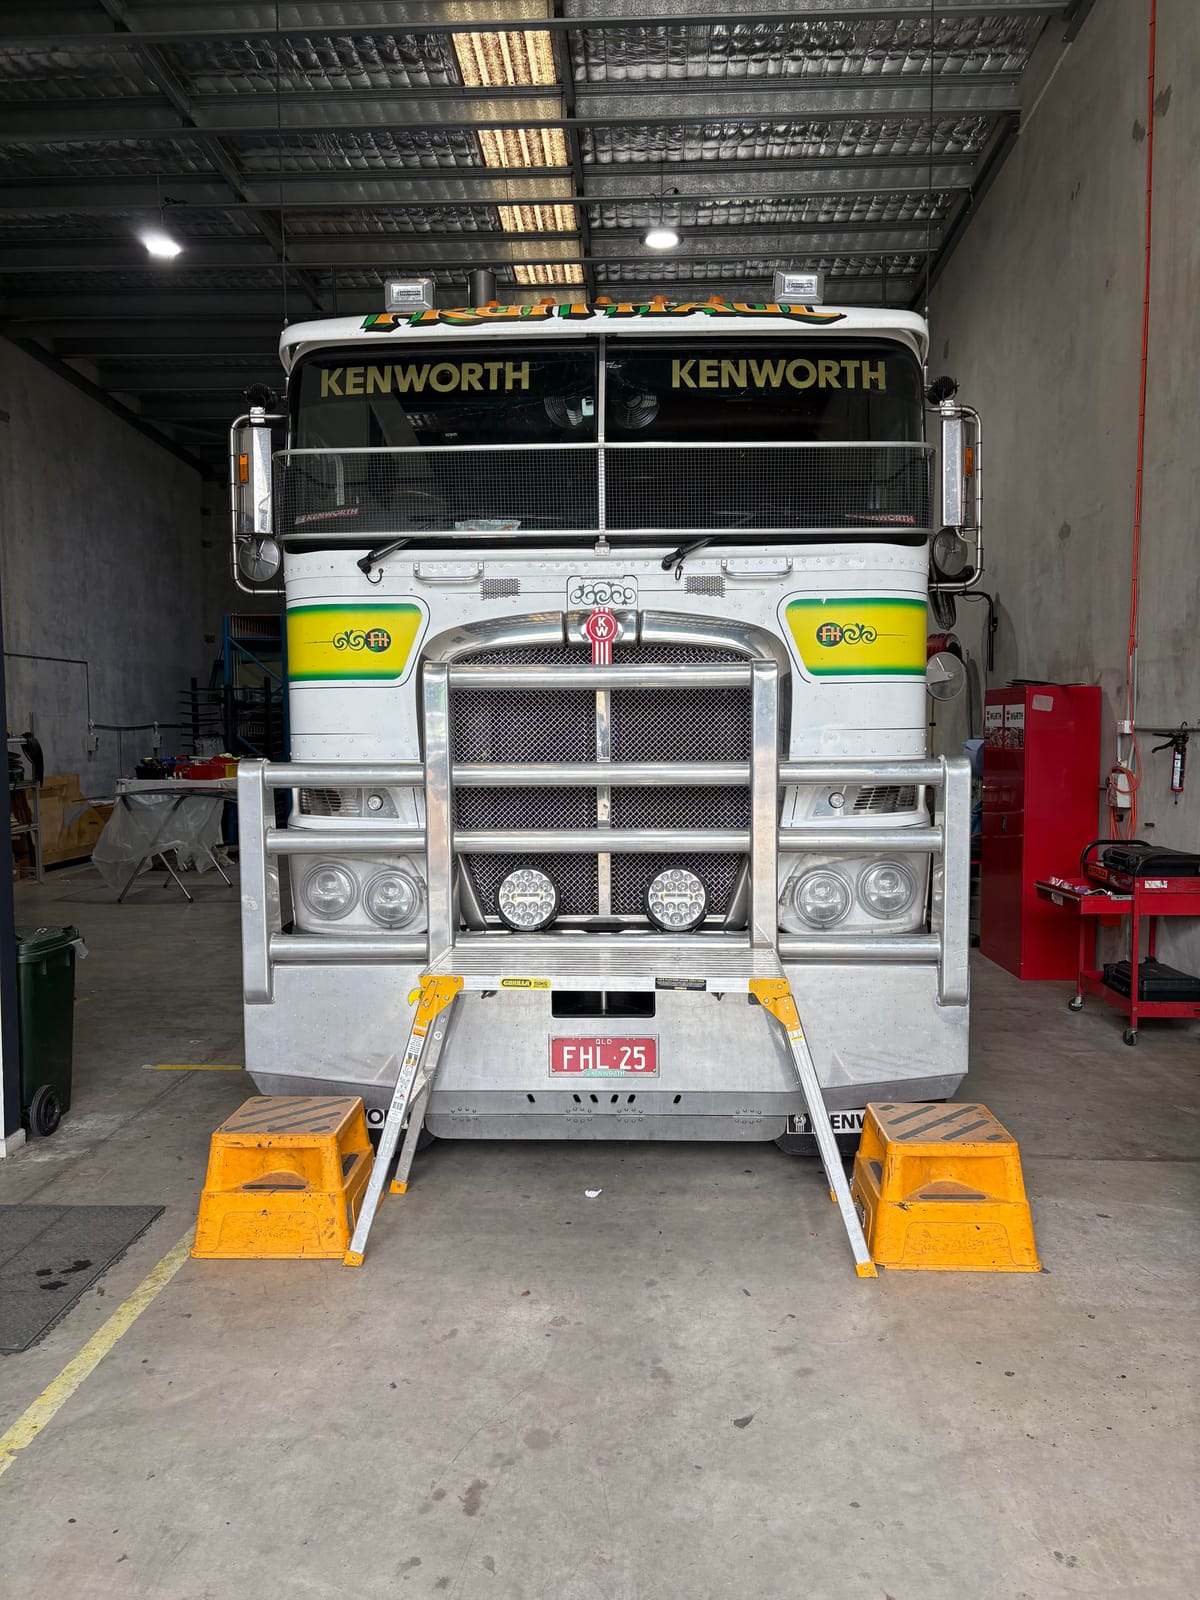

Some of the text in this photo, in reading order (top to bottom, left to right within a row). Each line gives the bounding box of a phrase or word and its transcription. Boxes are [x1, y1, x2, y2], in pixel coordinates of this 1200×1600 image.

[320, 361, 530, 397] KENWORTH
[671, 358, 887, 390] KENWORTH
[563, 1046, 646, 1070] FHL 25
